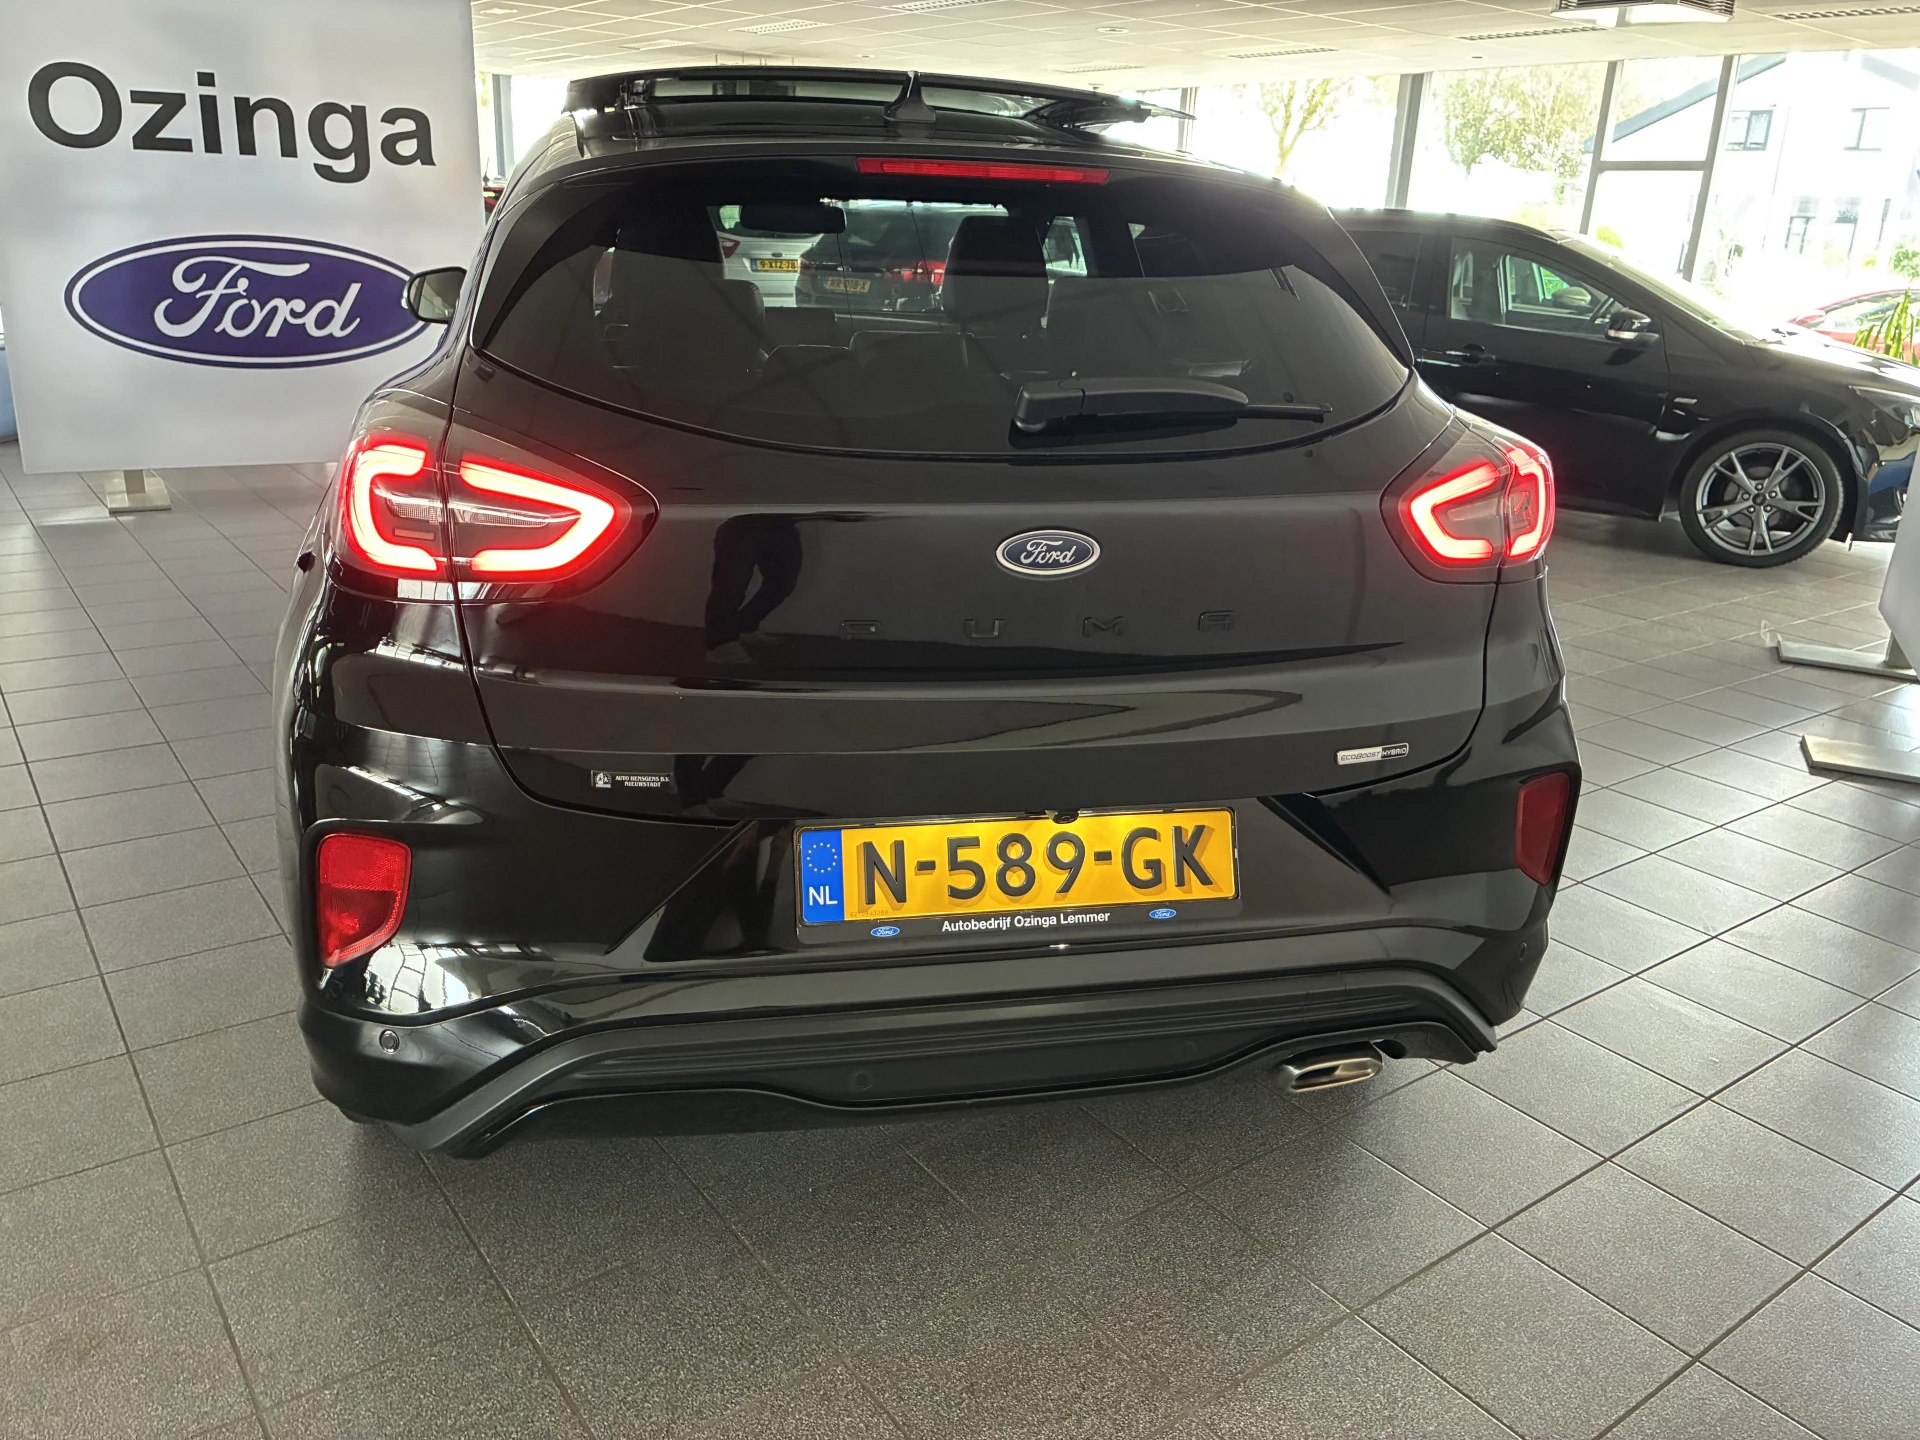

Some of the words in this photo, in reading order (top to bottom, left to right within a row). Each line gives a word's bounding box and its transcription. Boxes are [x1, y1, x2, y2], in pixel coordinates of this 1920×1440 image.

[28, 61, 436, 184] Ozinga
[153, 255, 361, 339] Ford
[1020, 539, 1077, 564] Ford
[840, 610, 1237, 640] PUMA
[1381, 747, 1407, 757] HYBRID
[864, 825, 1213, 905] N-589-GK
[808, 885, 838, 906] NL
[941, 916, 1012, 933] Autobedrijf
[1014, 914, 1057, 929] Ozinga
[1060, 911, 1111, 925] Lemmer
